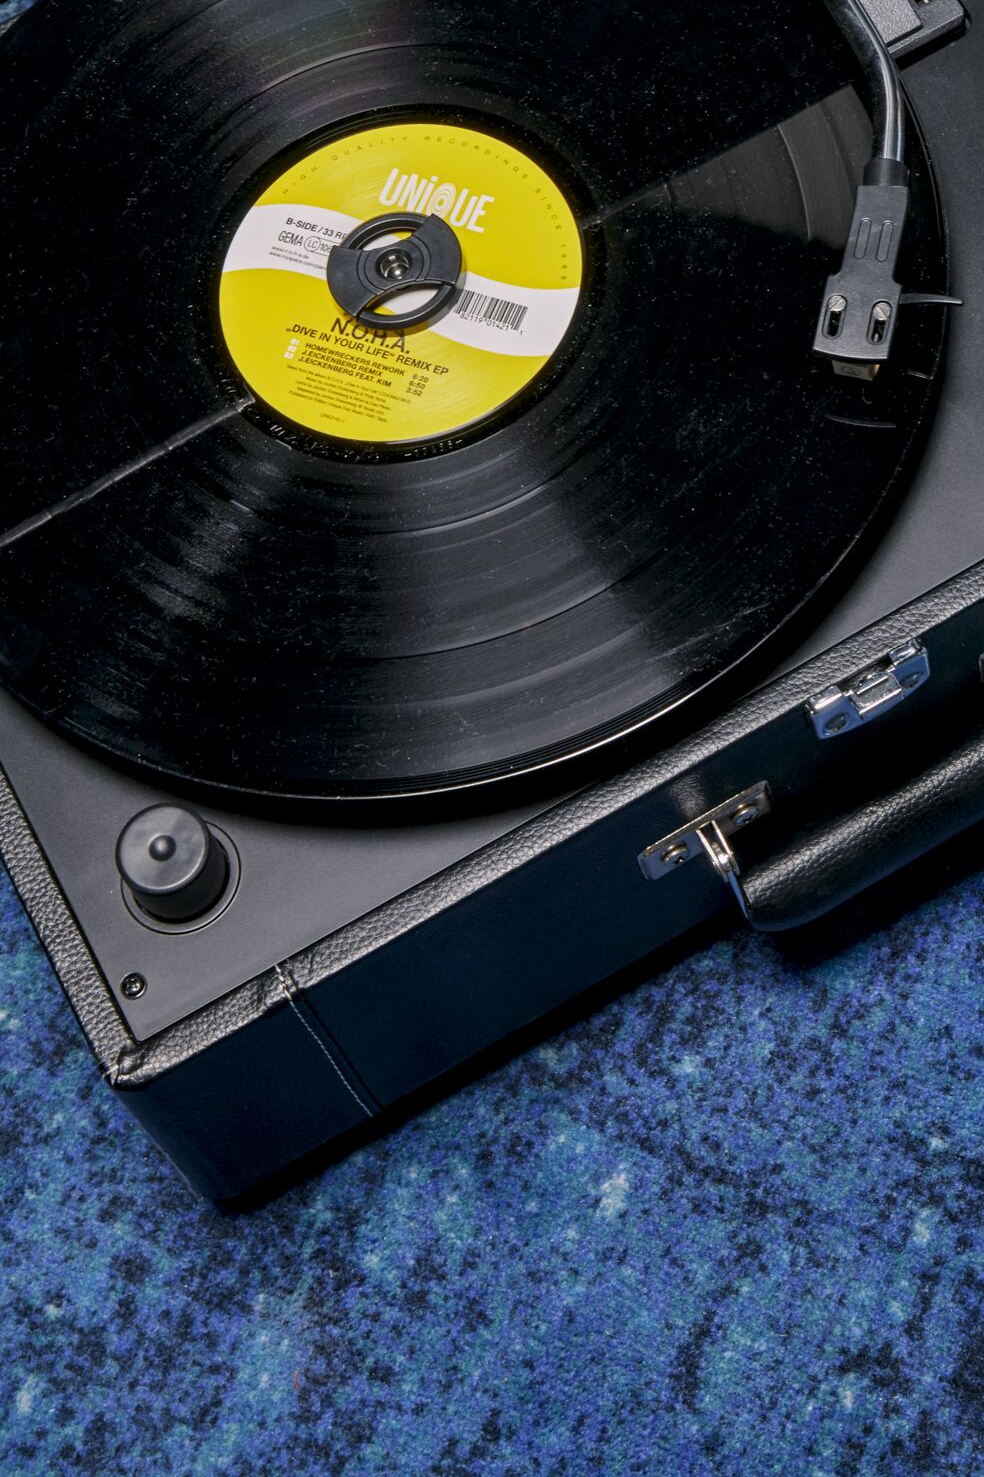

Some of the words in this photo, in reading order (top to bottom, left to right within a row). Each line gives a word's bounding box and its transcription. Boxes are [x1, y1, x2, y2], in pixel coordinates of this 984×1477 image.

[331, 135, 410, 163] QUALITY
[424, 134, 531, 181] RECORDINGS
[277, 229, 304, 247] GEMA
[285, 217, 318, 232] B-SIDE
[322, 227, 334, 237] 33
[459, 312, 483, 323] 82119
[329, 314, 414, 355] N.O.H.A.
[301, 349, 357, 369] J.EICKENBERG
[357, 364, 382, 377] REMIX
[304, 341, 371, 367] HOMEWRECKERS
[371, 361, 405, 376] REWORK
[318, 331, 331, 342] IN
[333, 335, 364, 352] YOUR
[395, 354, 432, 371] REMIX
[432, 364, 448, 375] EP
[298, 356, 354, 376] J.EICKENBERG
[354, 371, 374, 381] FEAT.
[376, 378, 392, 387] KIM
